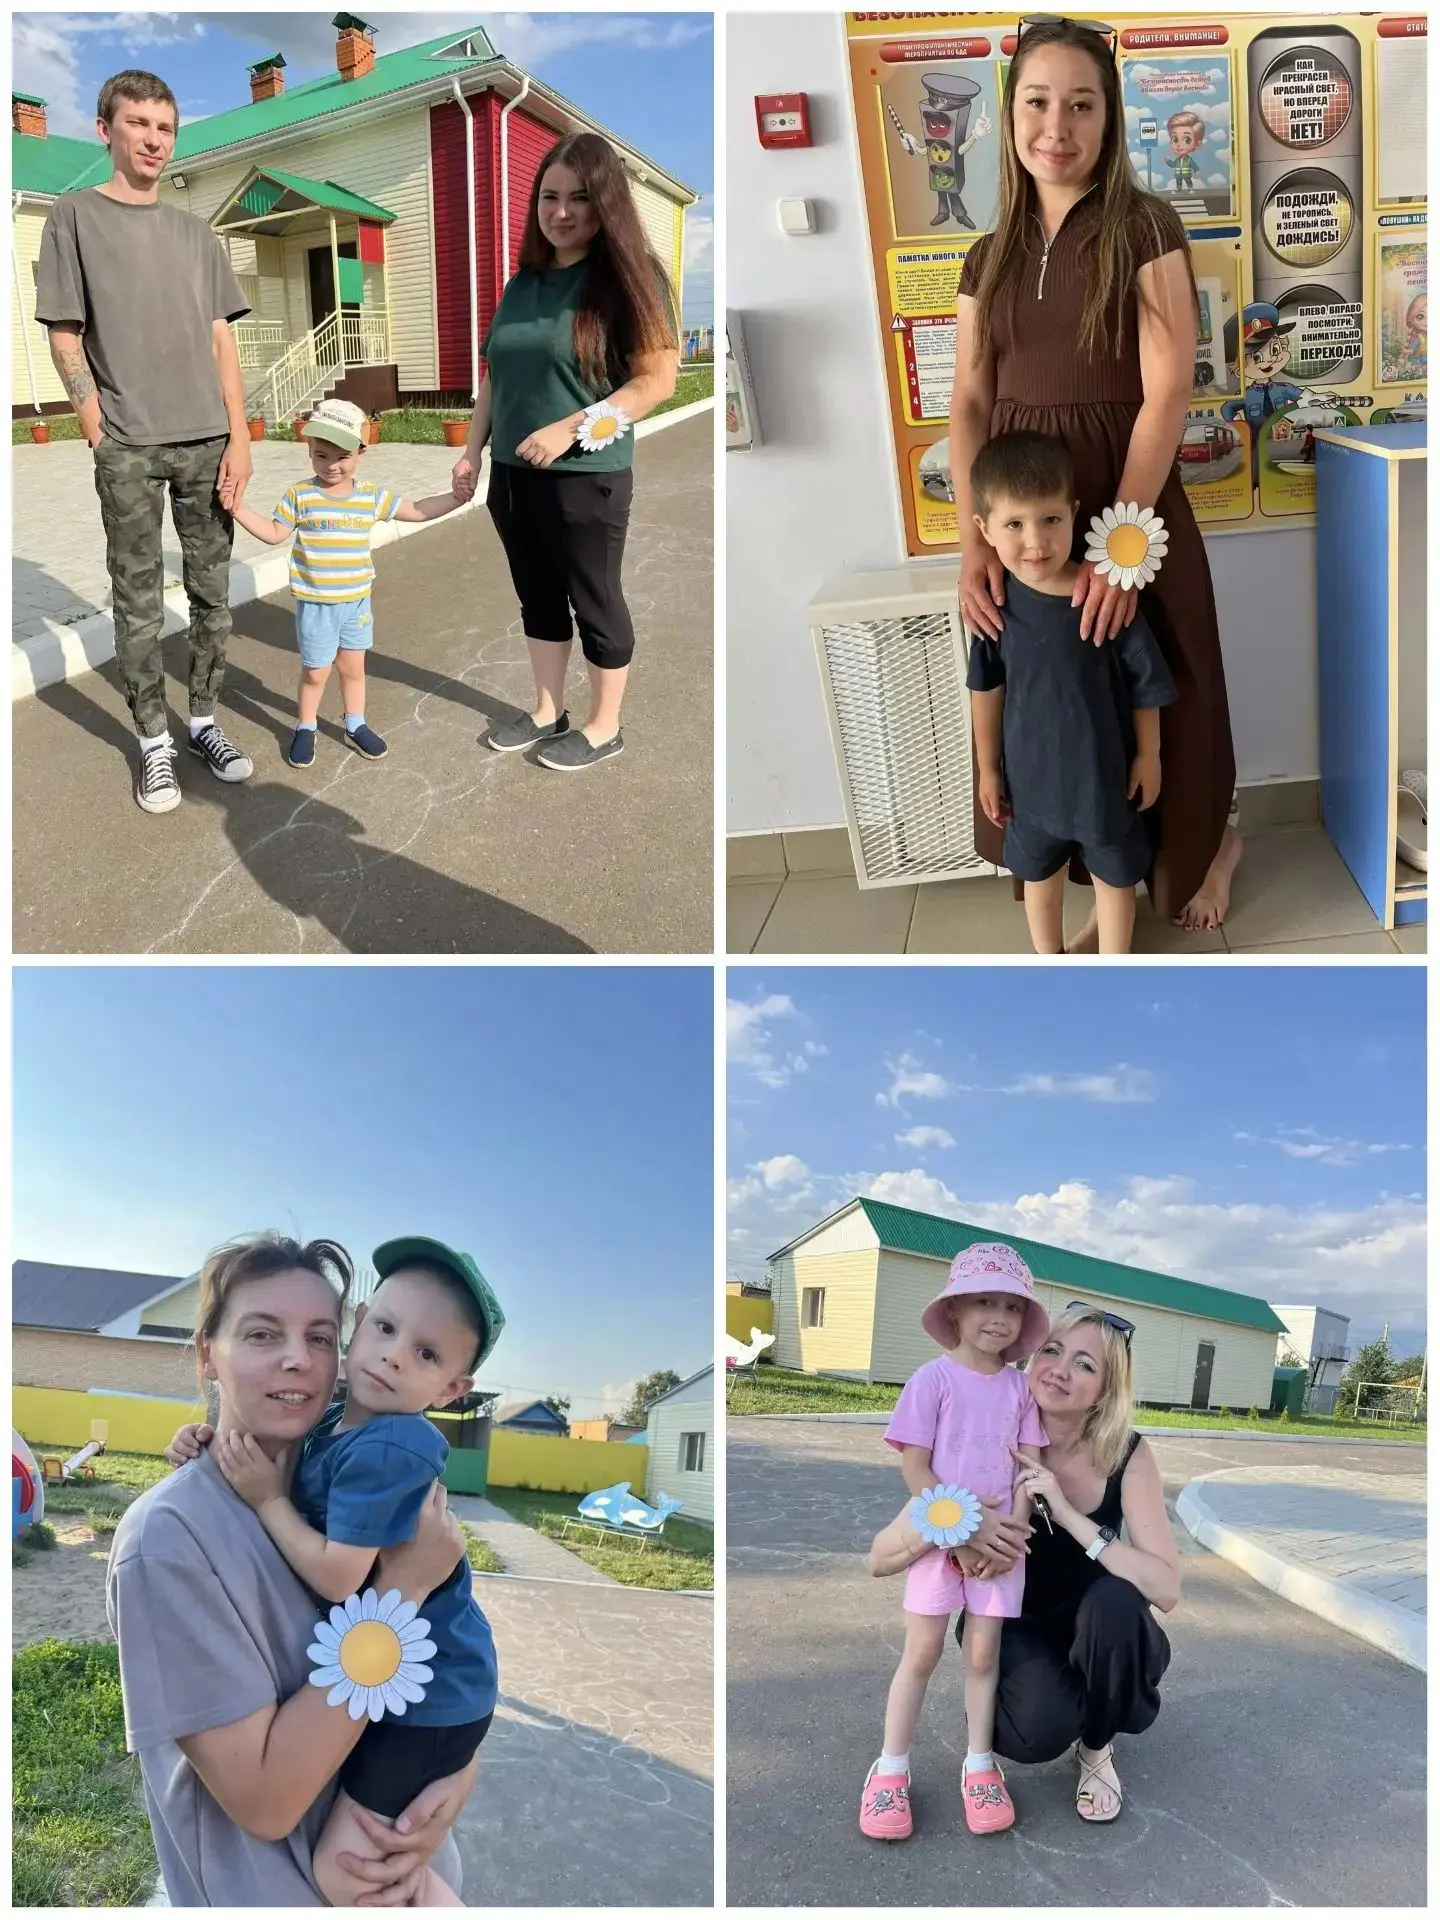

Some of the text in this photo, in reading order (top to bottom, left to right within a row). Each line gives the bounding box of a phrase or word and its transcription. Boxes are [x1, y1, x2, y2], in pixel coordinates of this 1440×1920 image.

[1129, 31, 1220, 44] РОДИТЕЛИ, ВНИМАНИЕ!
[955, 48, 967, 56] БДД
[1296, 61, 1313, 70] КАК
[1282, 72, 1328, 82] ПРЕКРАСЕН
[1273, 83, 1338, 95] КРАСНЫЙ СВЕТ,
[1283, 96, 1328, 107] НО ВПЕРЕД
[1290, 109, 1322, 120] ДОРОГИ
[1290, 122, 1323, 139] НЕТ!
[1276, 192, 1338, 208] ПОДОЖДИ,
[1282, 211, 1291, 219] НЕ
[1276, 218, 1338, 230] И ЗЕЛЕНЫЙ СВЕТ
[1276, 230, 1339, 247] ДОЖДИСЬ!
[898, 251, 967, 263] ПАМЯТКА ЮНОГО ПЕ
[1299, 304, 1361, 316] ВЛЕВО, ВПРАВО
[1308, 317, 1353, 328] ПОСМОТРИ:
[1301, 330, 1360, 342] ВНИМАТЕЛЬНО
[907, 340, 912, 348] 1
[1300, 344, 1361, 360] ПЕРЕХОДИ
[909, 363, 915, 371] 2
[911, 378, 916, 386] 3
[913, 397, 918, 405] 4
